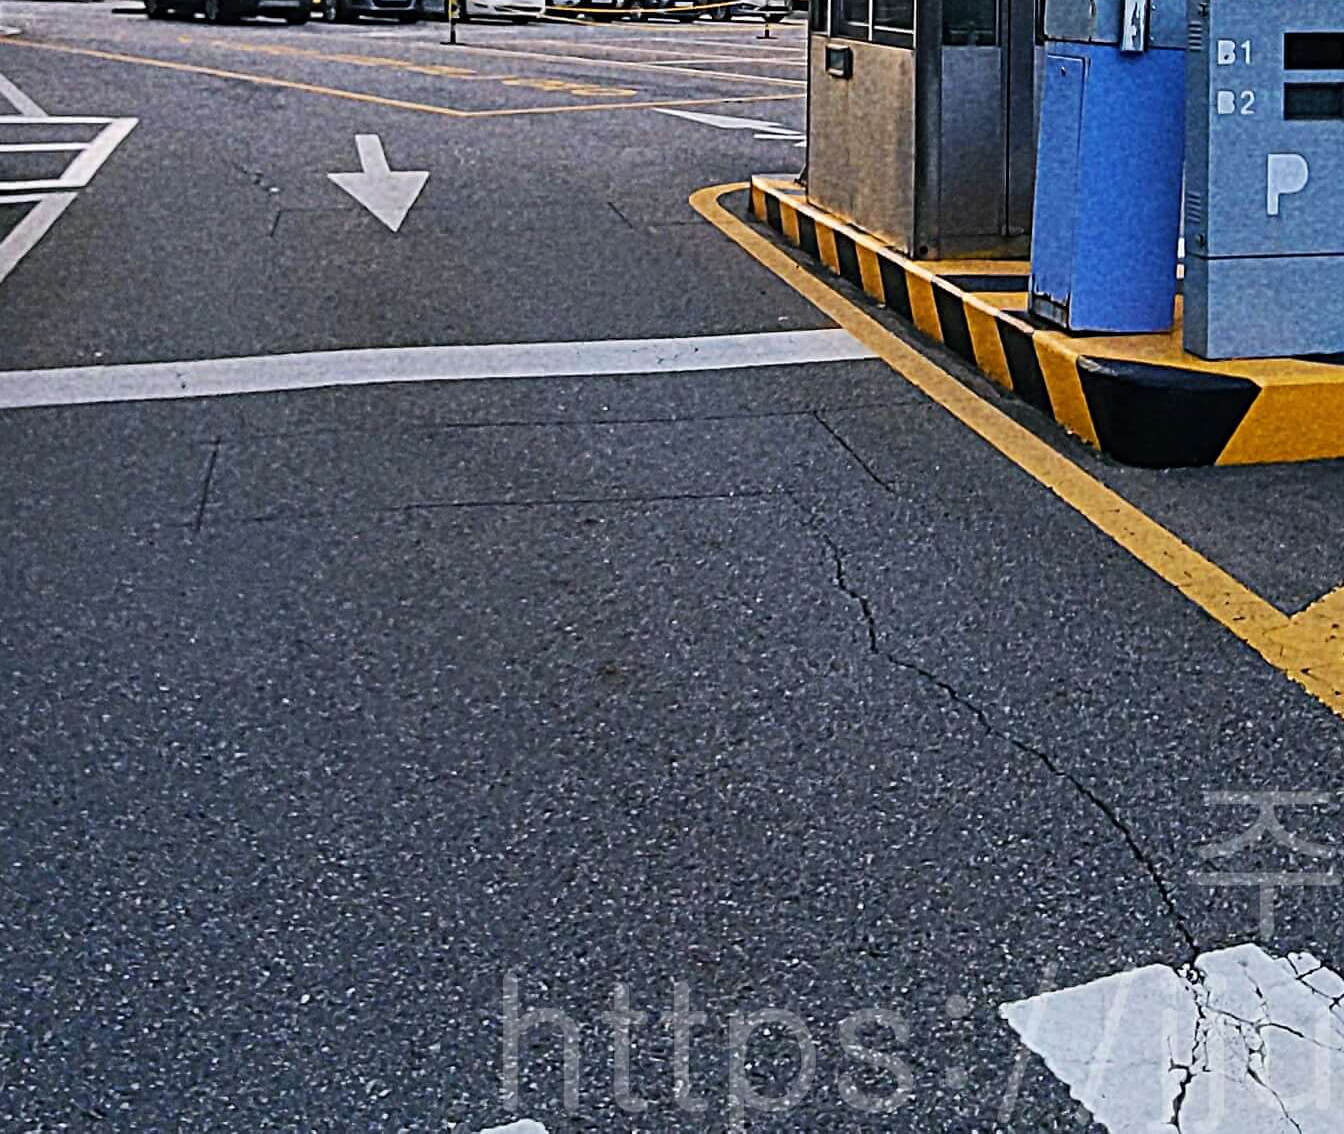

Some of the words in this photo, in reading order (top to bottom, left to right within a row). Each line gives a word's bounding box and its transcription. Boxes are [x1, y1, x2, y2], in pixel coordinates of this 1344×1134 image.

[1216, 39, 1253, 66] B1
[1216, 90, 1256, 116] B2
[1266, 152, 1309, 217] P
